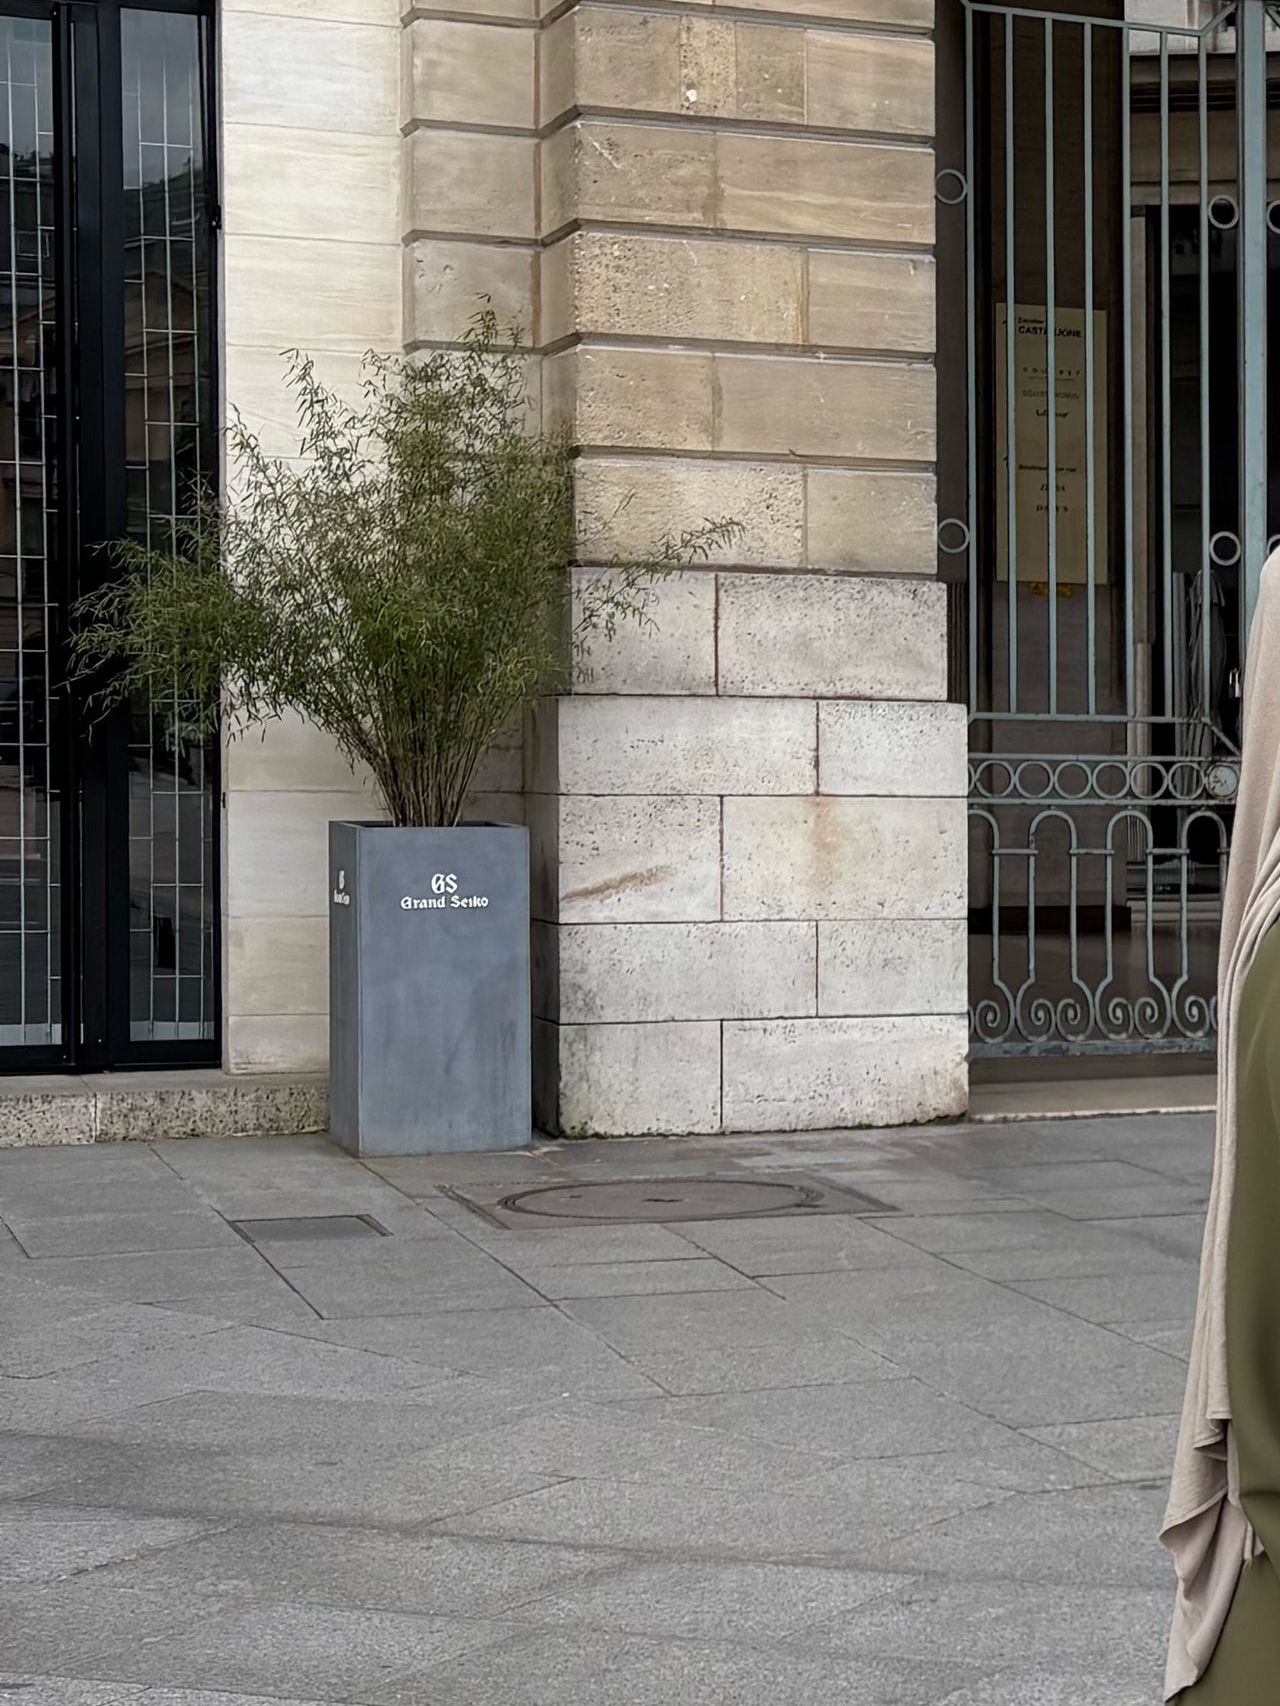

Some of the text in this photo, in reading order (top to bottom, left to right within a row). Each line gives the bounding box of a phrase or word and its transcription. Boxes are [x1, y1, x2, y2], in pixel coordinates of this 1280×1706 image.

[431, 873, 458, 894] GS
[401, 895, 489, 910] Grand Seiko
